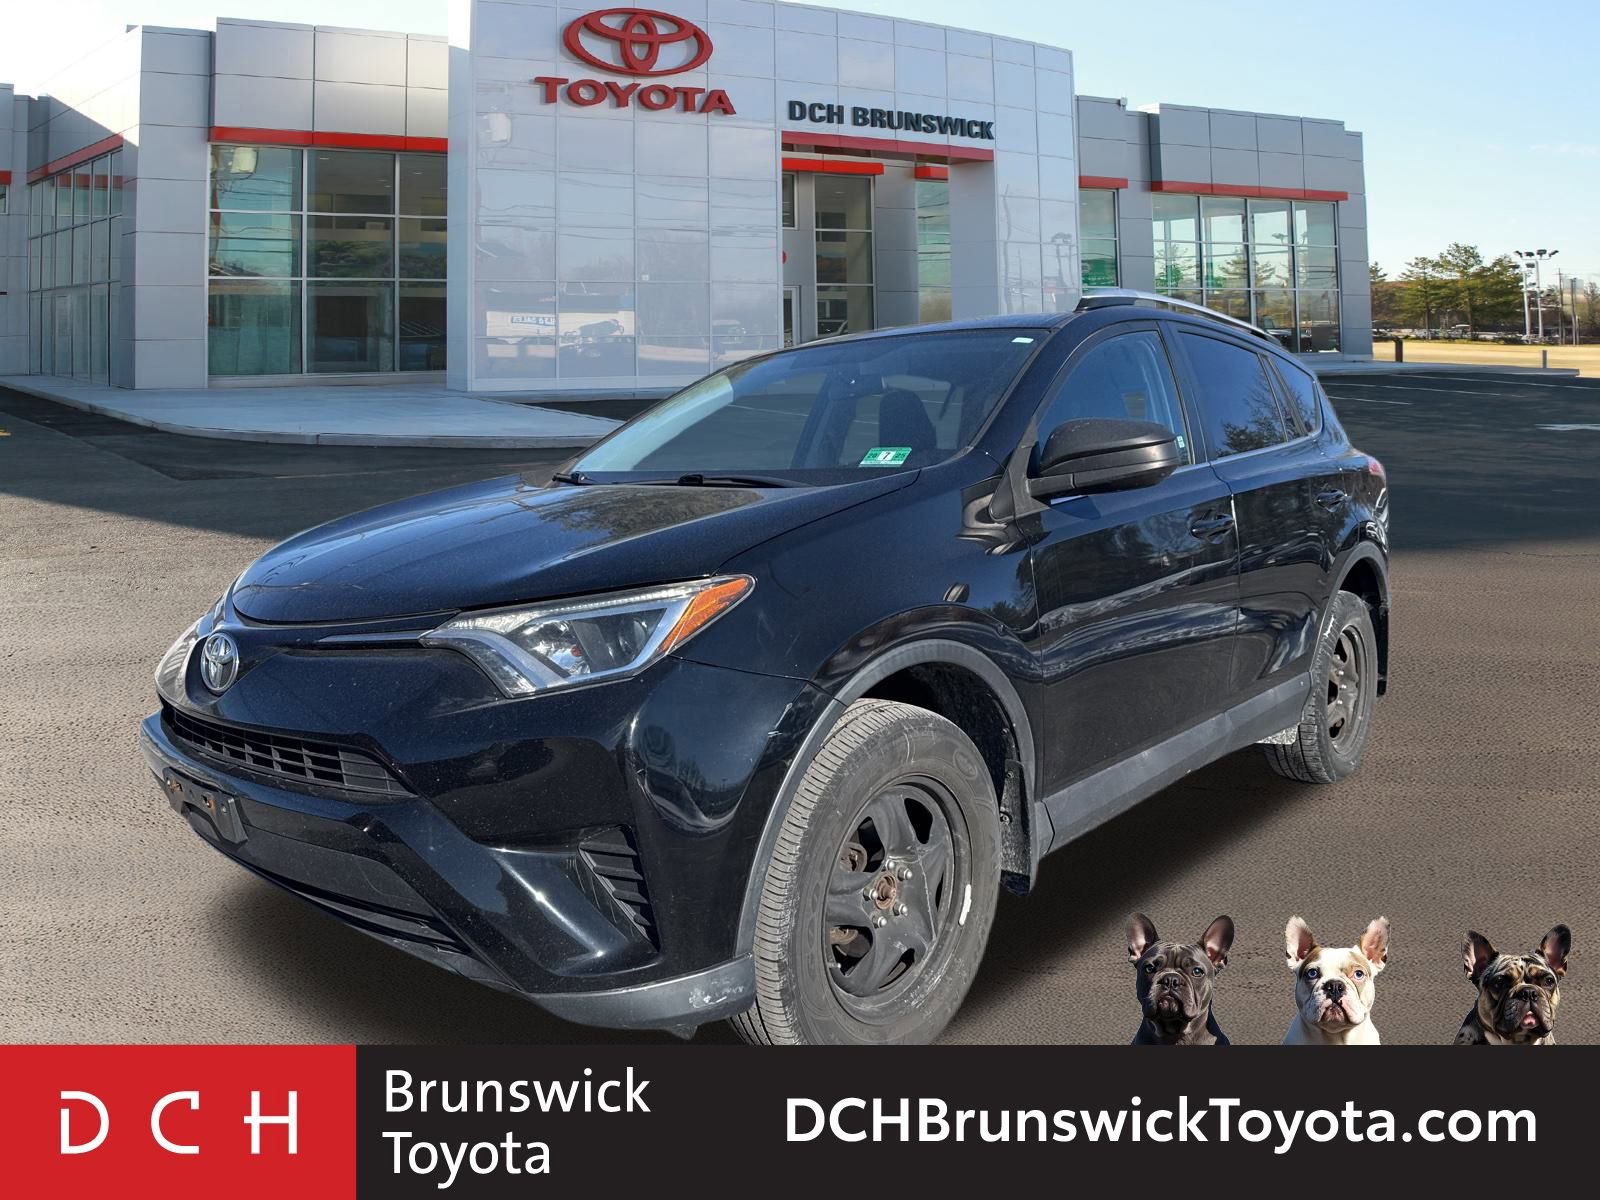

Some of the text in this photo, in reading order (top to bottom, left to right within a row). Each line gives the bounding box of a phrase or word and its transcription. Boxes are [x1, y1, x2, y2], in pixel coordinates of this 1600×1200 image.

[534, 76, 737, 116] TOYOTA
[788, 99, 995, 141] DCH BRUNSWICK
